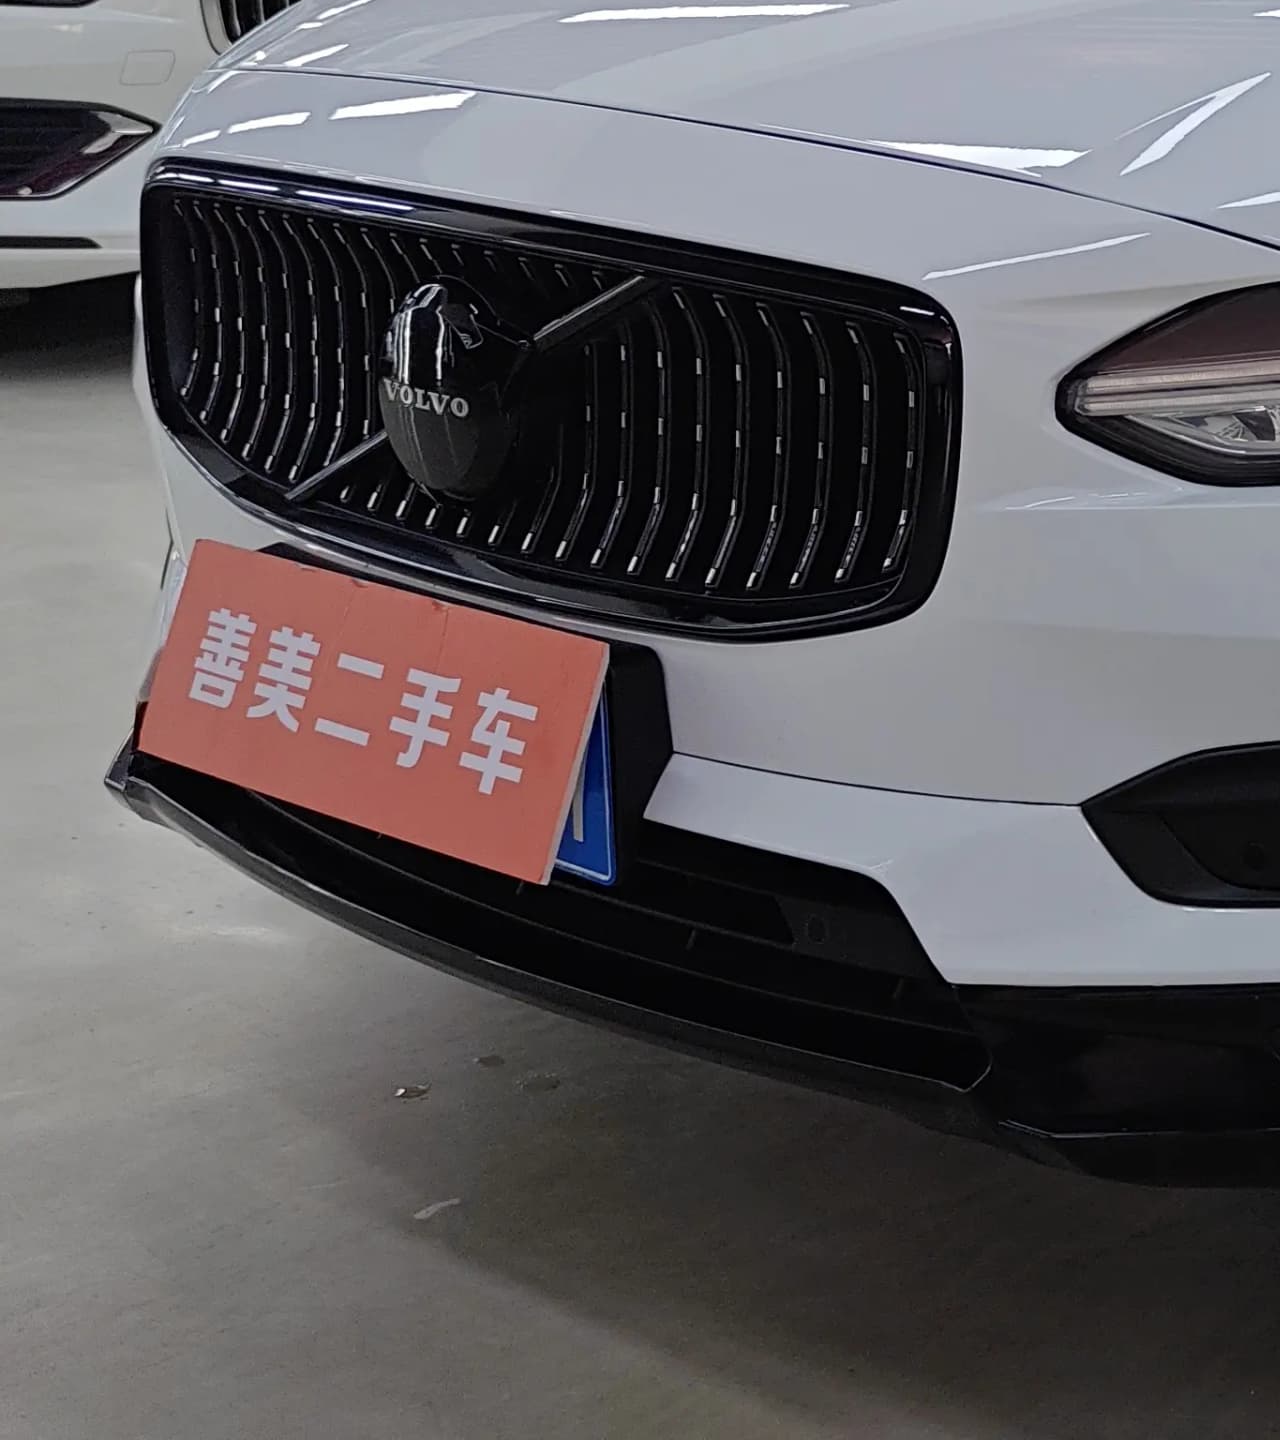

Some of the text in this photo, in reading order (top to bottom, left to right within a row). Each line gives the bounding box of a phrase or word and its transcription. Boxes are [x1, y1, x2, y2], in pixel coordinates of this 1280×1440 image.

[383, 377, 470, 418] VOLVO
[187, 608, 540, 796] 善美二手车
